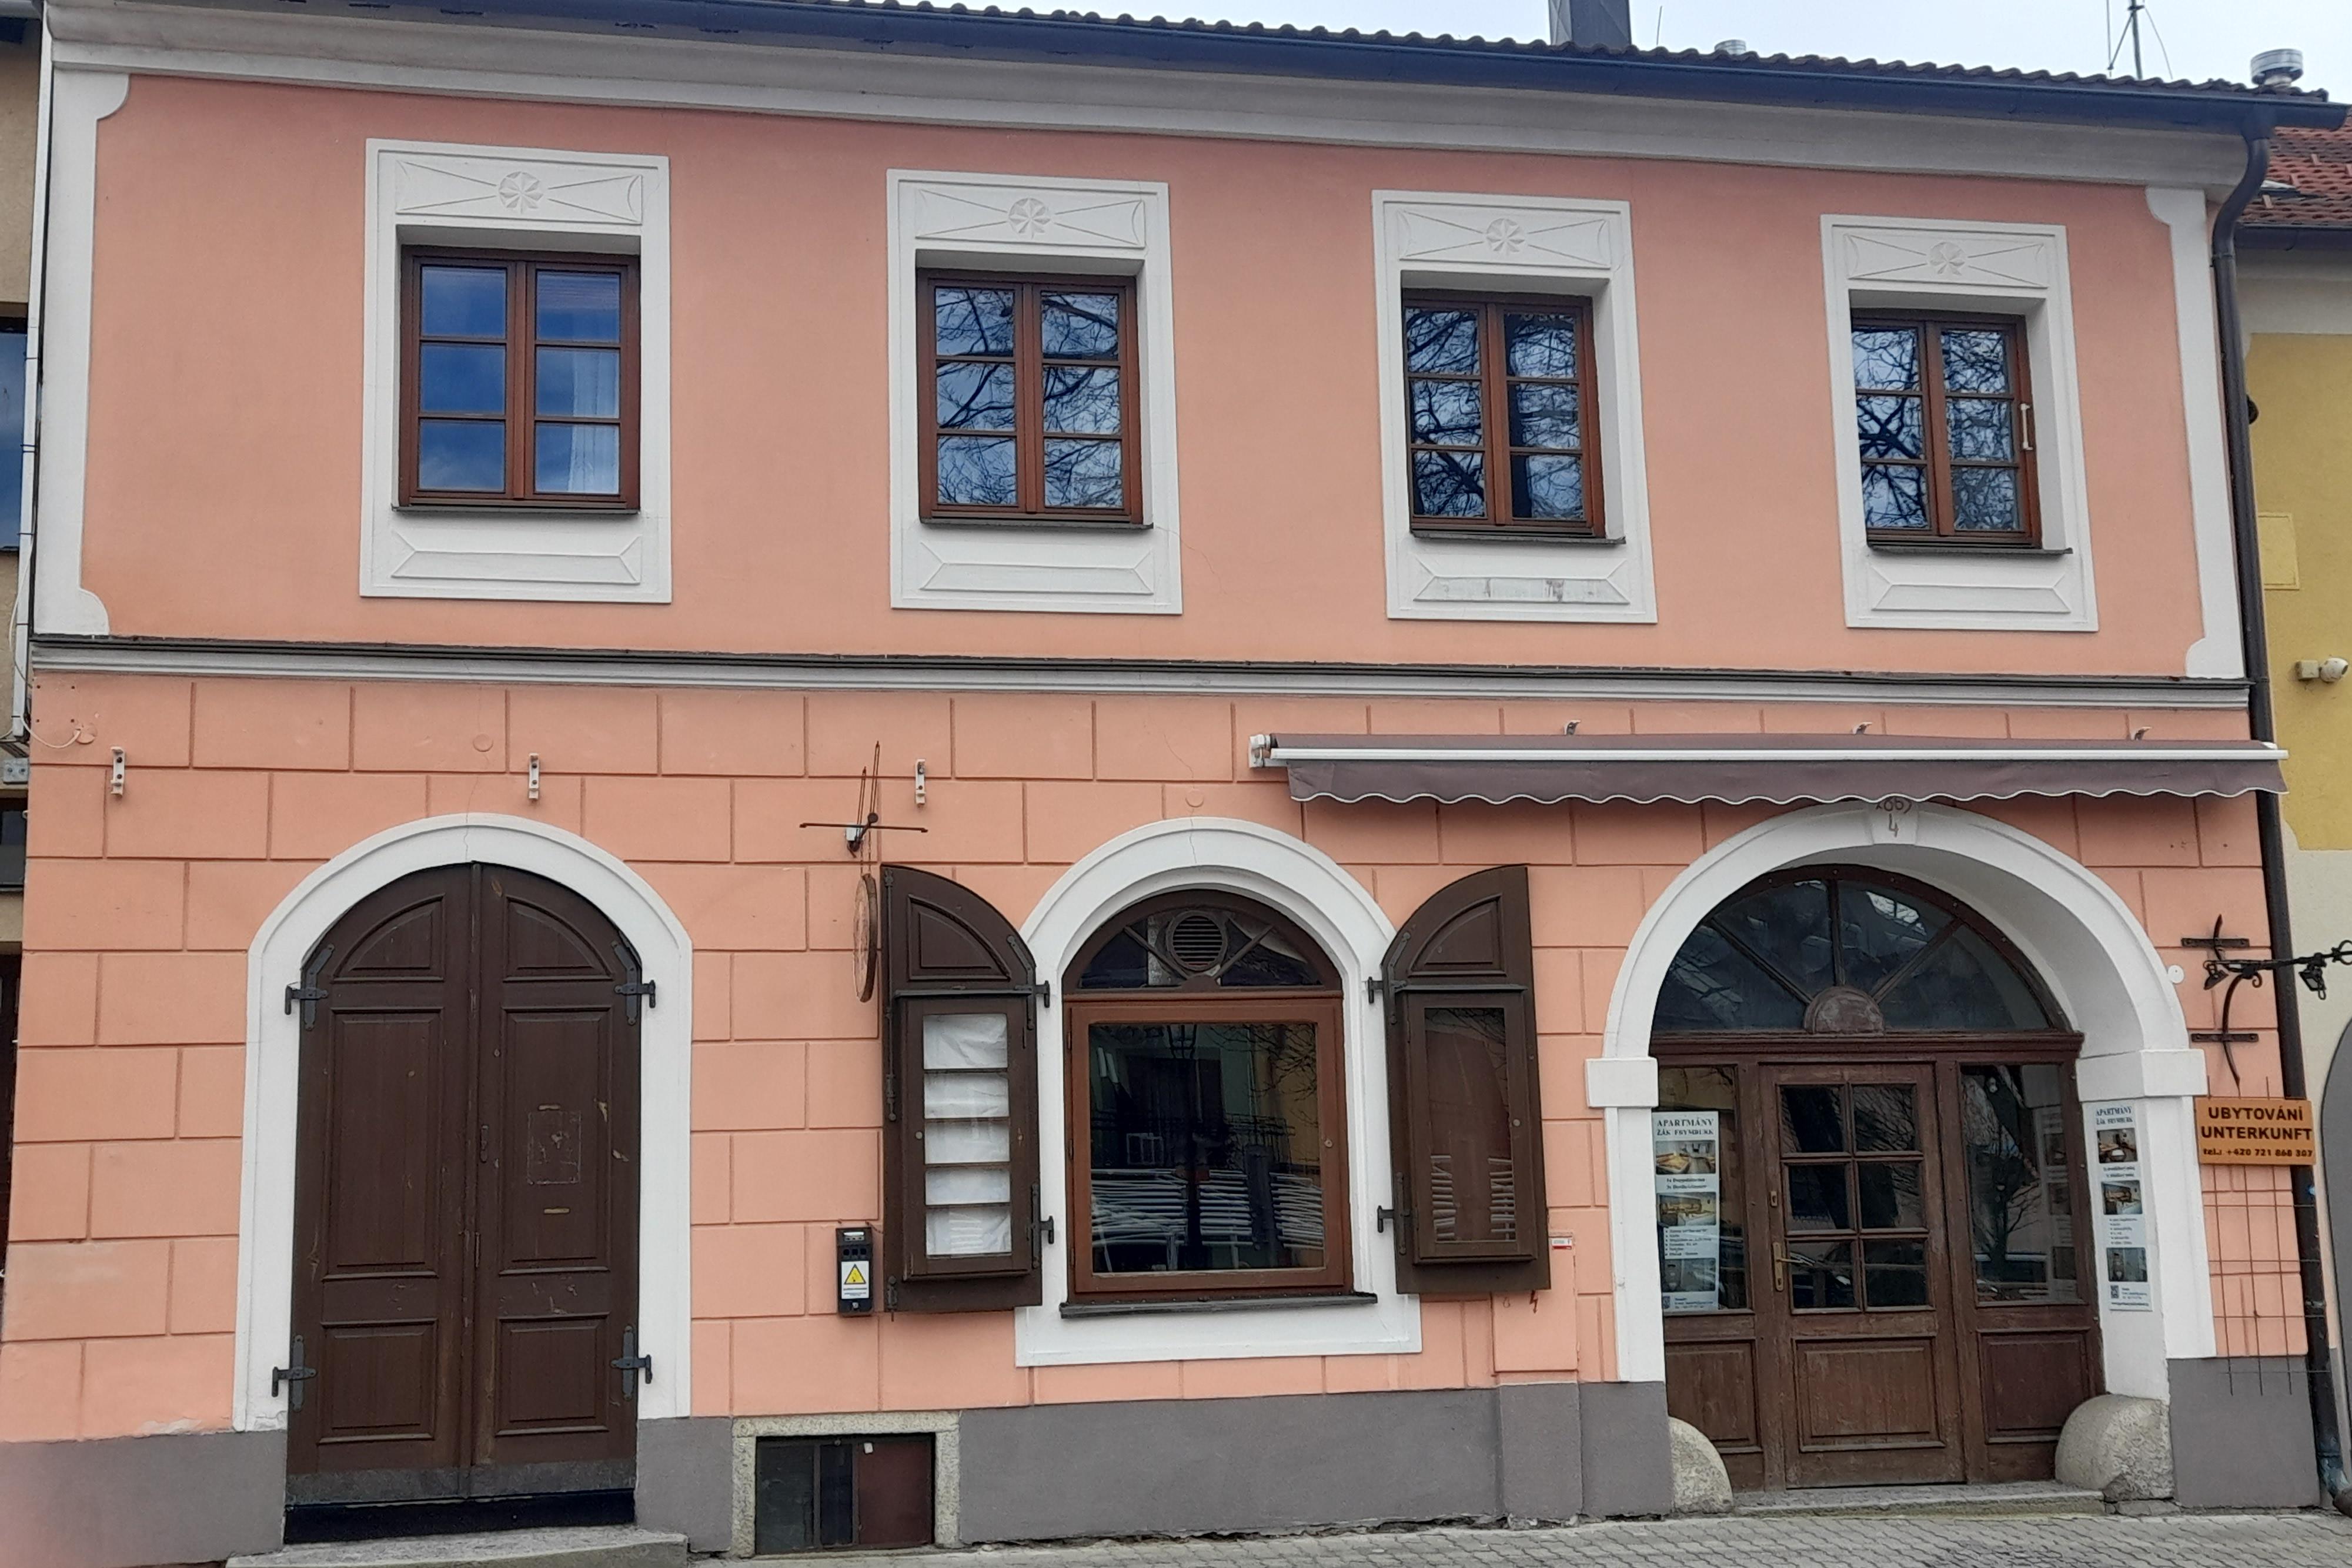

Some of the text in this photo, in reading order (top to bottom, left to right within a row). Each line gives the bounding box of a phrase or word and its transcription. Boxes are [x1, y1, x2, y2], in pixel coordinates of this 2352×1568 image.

[2208, 1106, 2303, 1121] UBYTOVÁNÍ
[1657, 1117, 1714, 1126] APARTMÁNY
[2201, 1126, 2313, 1140] UNTERKUNFT
